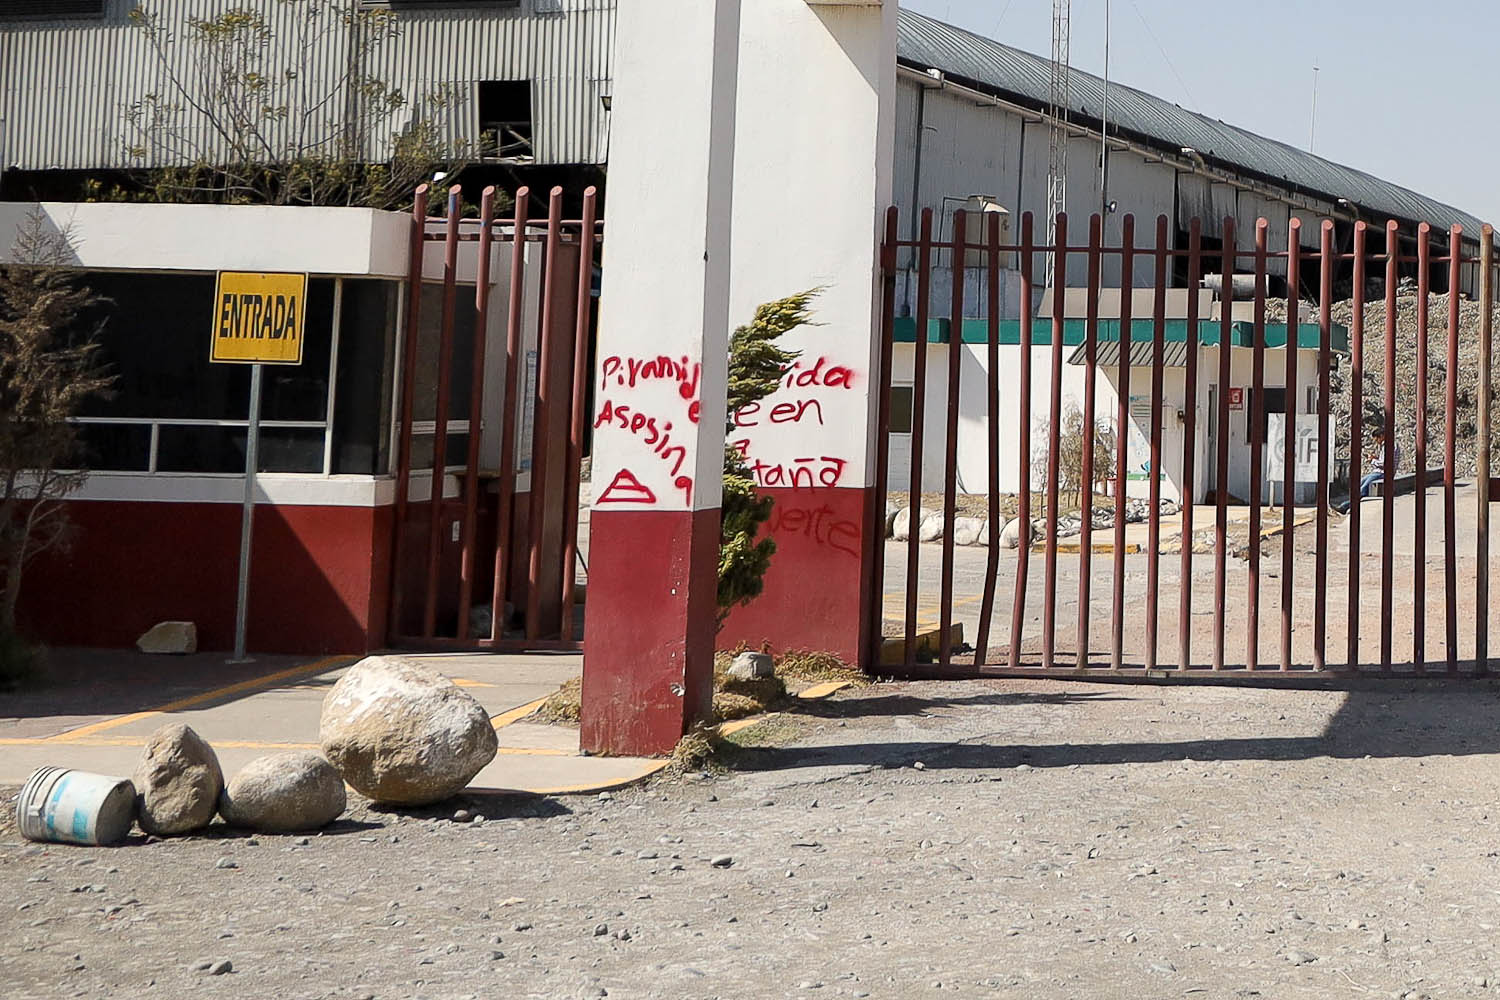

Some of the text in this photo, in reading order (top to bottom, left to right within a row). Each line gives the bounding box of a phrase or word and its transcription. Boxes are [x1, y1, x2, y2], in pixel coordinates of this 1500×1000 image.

[219, 293, 296, 339] ENTRADA
[779, 356, 856, 390] ida
[769, 399, 823, 426] en
[752, 456, 848, 494] taña
